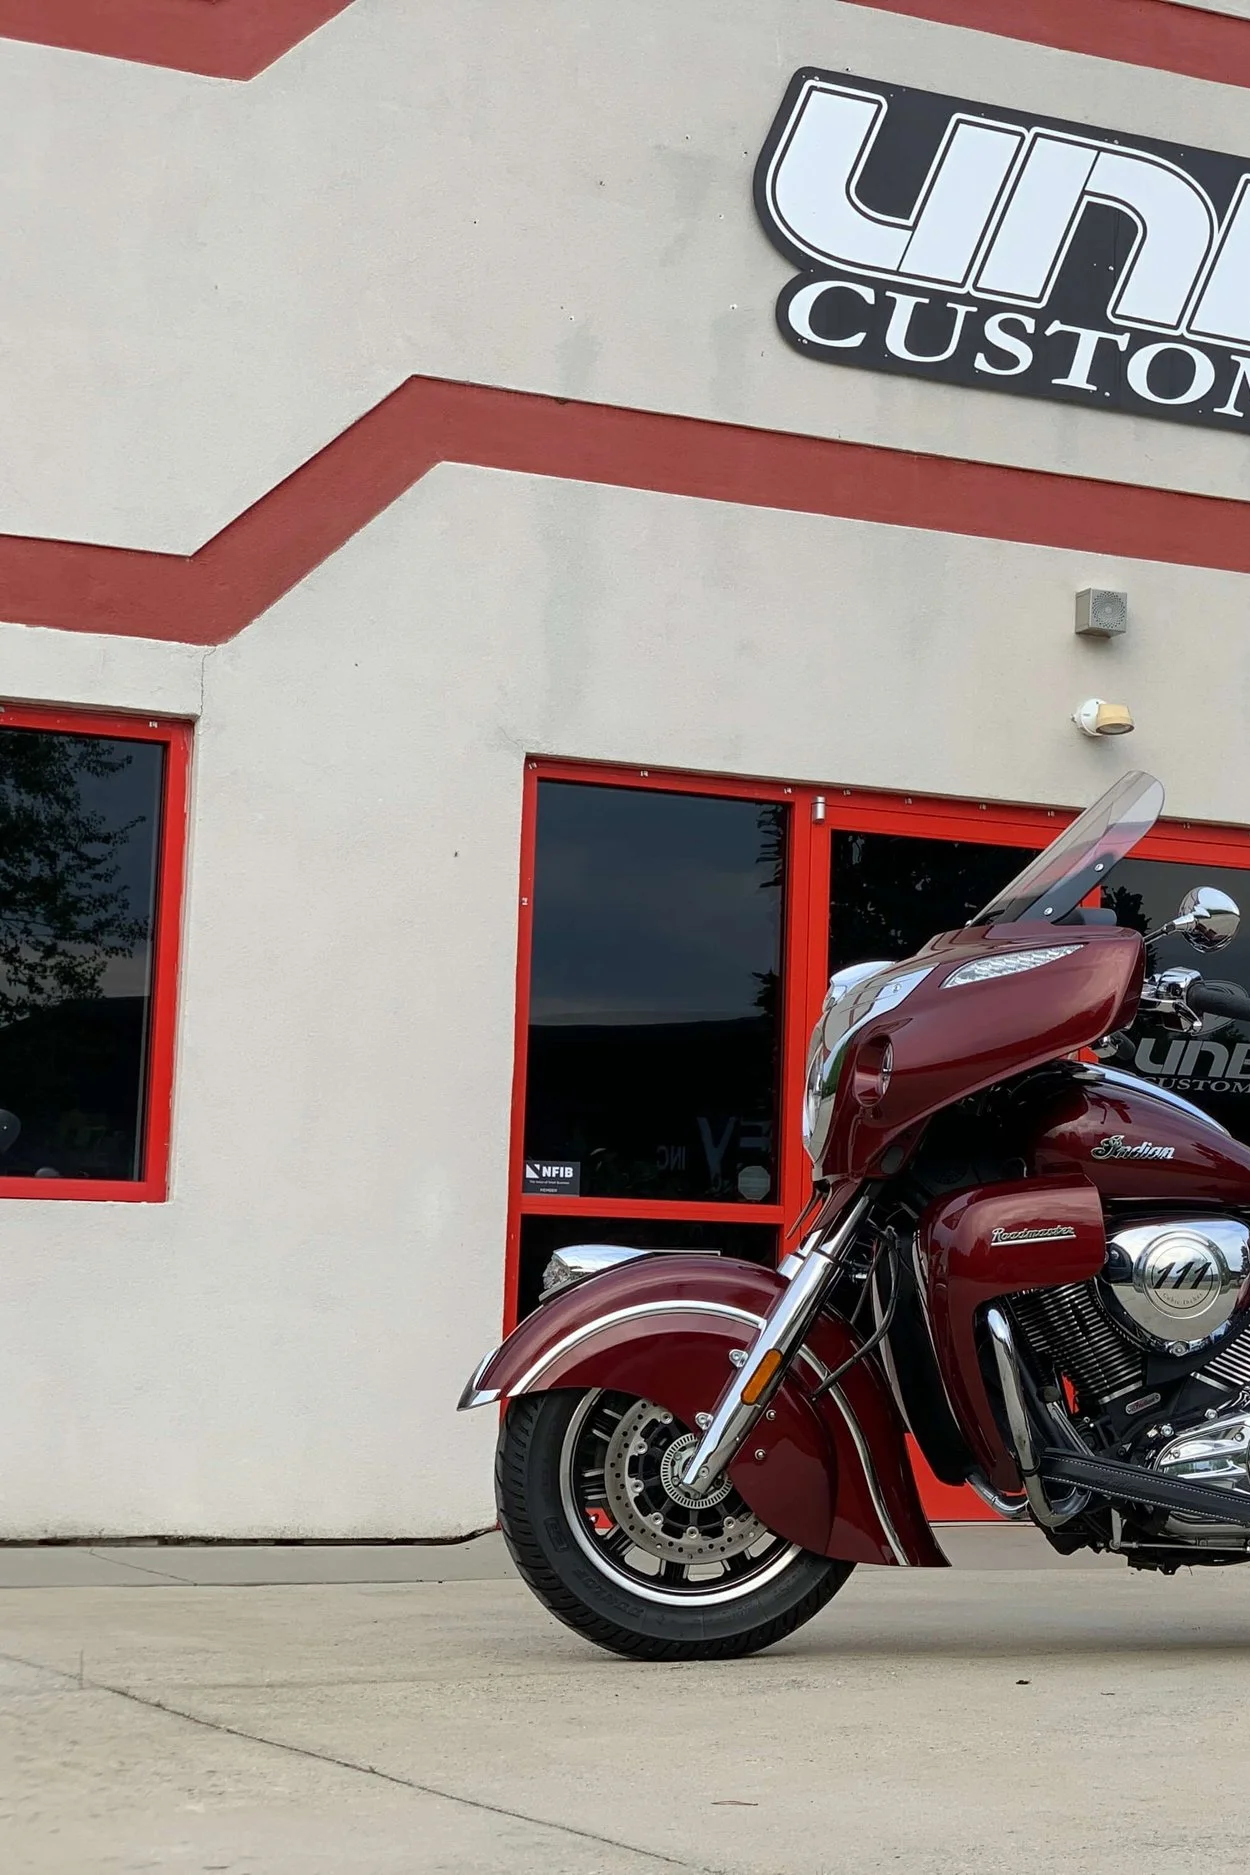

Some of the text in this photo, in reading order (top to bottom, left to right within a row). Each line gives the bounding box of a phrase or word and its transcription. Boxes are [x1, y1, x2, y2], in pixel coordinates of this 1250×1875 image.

[1091, 1134, 1175, 1160] Indian
[542, 1165, 574, 1178] NFIB
[991, 1225, 1075, 1243] Roadmaster
[1153, 1262, 1211, 1289] 111
